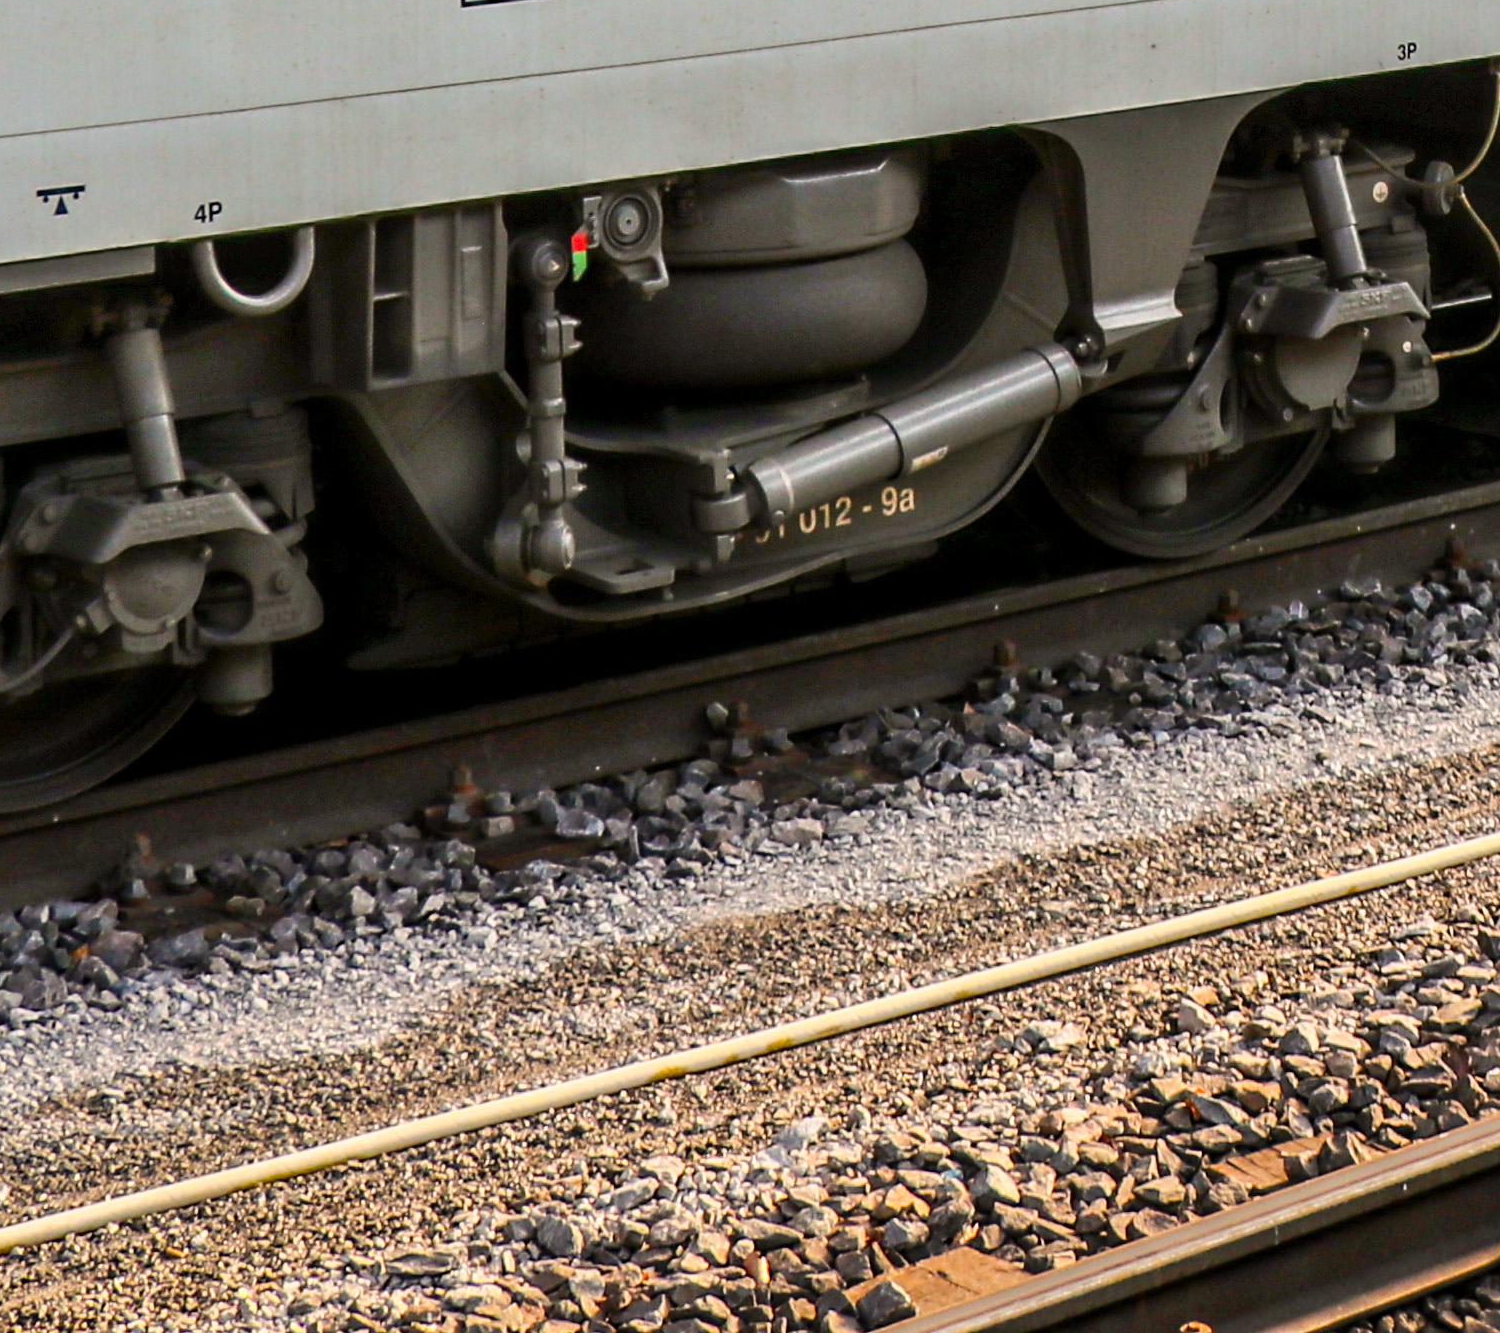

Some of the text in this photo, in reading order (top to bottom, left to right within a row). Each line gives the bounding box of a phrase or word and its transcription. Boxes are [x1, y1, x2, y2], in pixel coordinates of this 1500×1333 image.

[1396, 41, 1418, 61] 3P
[193, 201, 224, 224] 4P
[799, 496, 853, 534] 012
[881, 486, 916, 517] 9a
